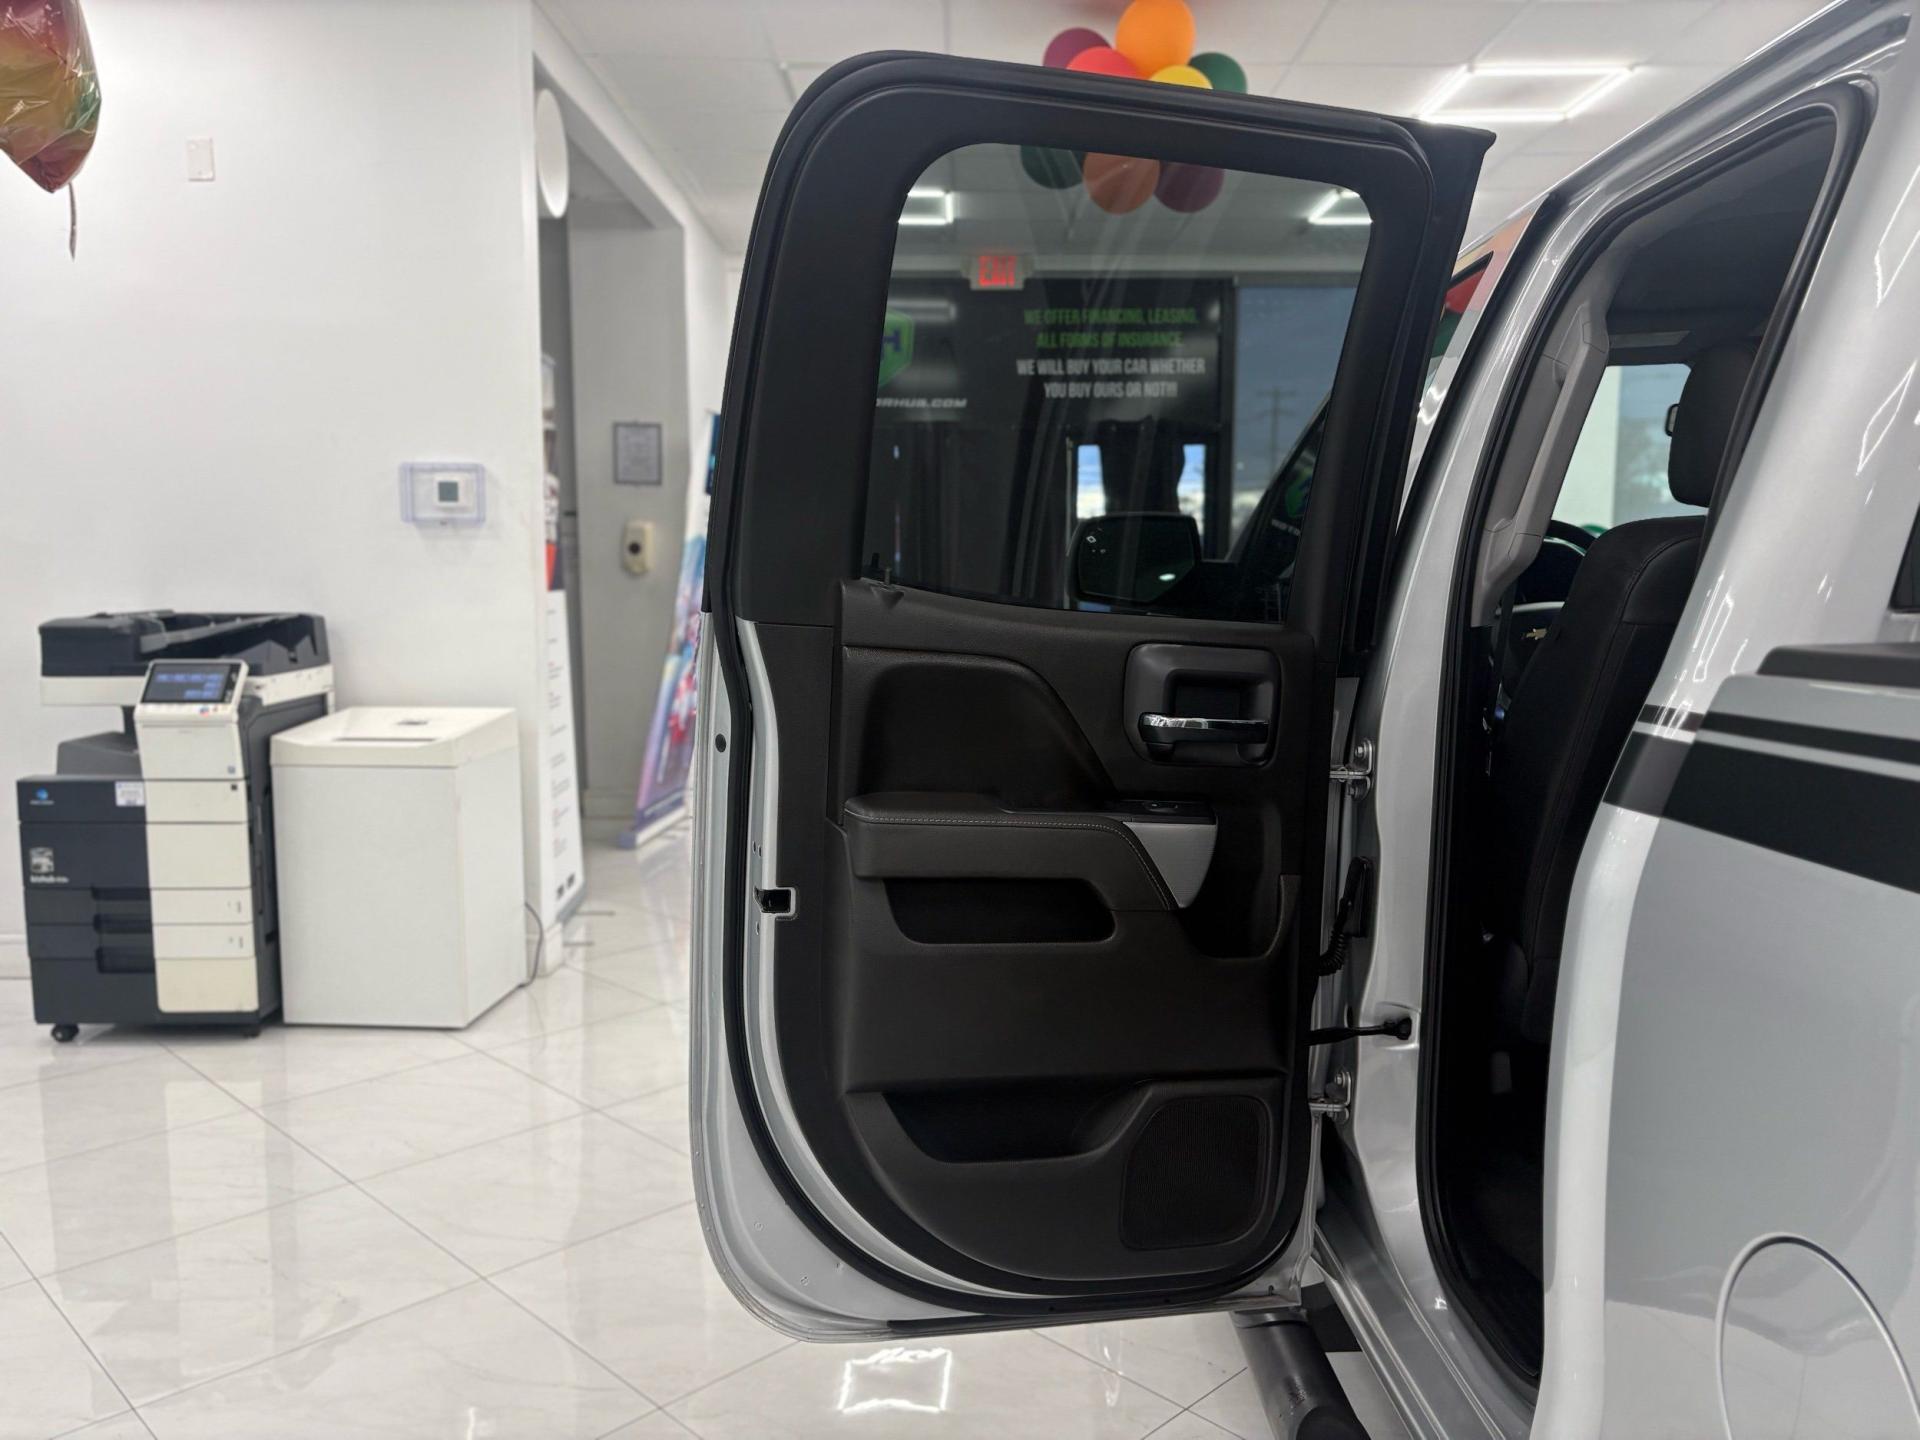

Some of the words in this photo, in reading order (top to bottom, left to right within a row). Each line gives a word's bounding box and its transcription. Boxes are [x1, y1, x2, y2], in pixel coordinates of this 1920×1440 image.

[978, 255, 1017, 287] EXIT
[1023, 308, 1042, 324] WE
[1044, 308, 1081, 324] OFFER
[1036, 332, 1059, 348] ALL
[1060, 332, 1099, 348] FORMS
[1101, 332, 1116, 348] OF
[1016, 358, 1035, 375] WE
[1037, 358, 1064, 375] WILL
[1066, 358, 1090, 375] BUY
[1091, 358, 1122, 375] YOUR
[1124, 358, 1148, 375] CAR
[1150, 358, 1206, 375] WHETHER
[1044, 382, 1066, 398] YOU
[1068, 382, 1092, 398] BUY
[1093, 382, 1124, 398] OURS
[1126, 382, 1142, 398] OR
